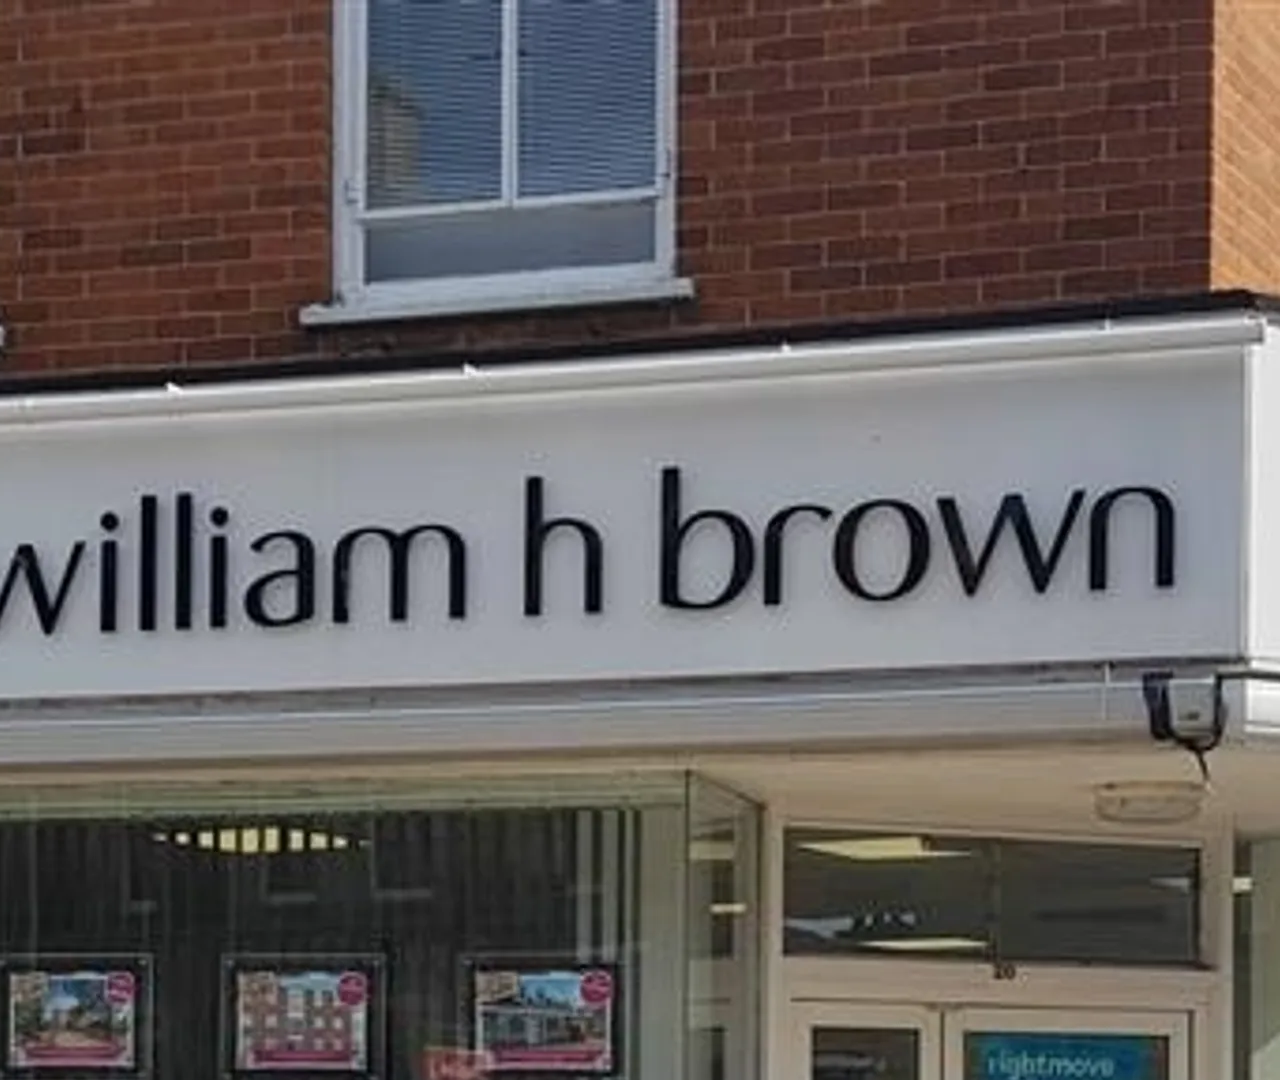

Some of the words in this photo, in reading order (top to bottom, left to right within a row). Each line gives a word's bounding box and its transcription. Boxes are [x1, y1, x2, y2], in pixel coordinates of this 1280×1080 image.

[522, 474, 606, 618] h
[657, 465, 1177, 612] brown
[987, 1051, 1115, 1080] rightmove
